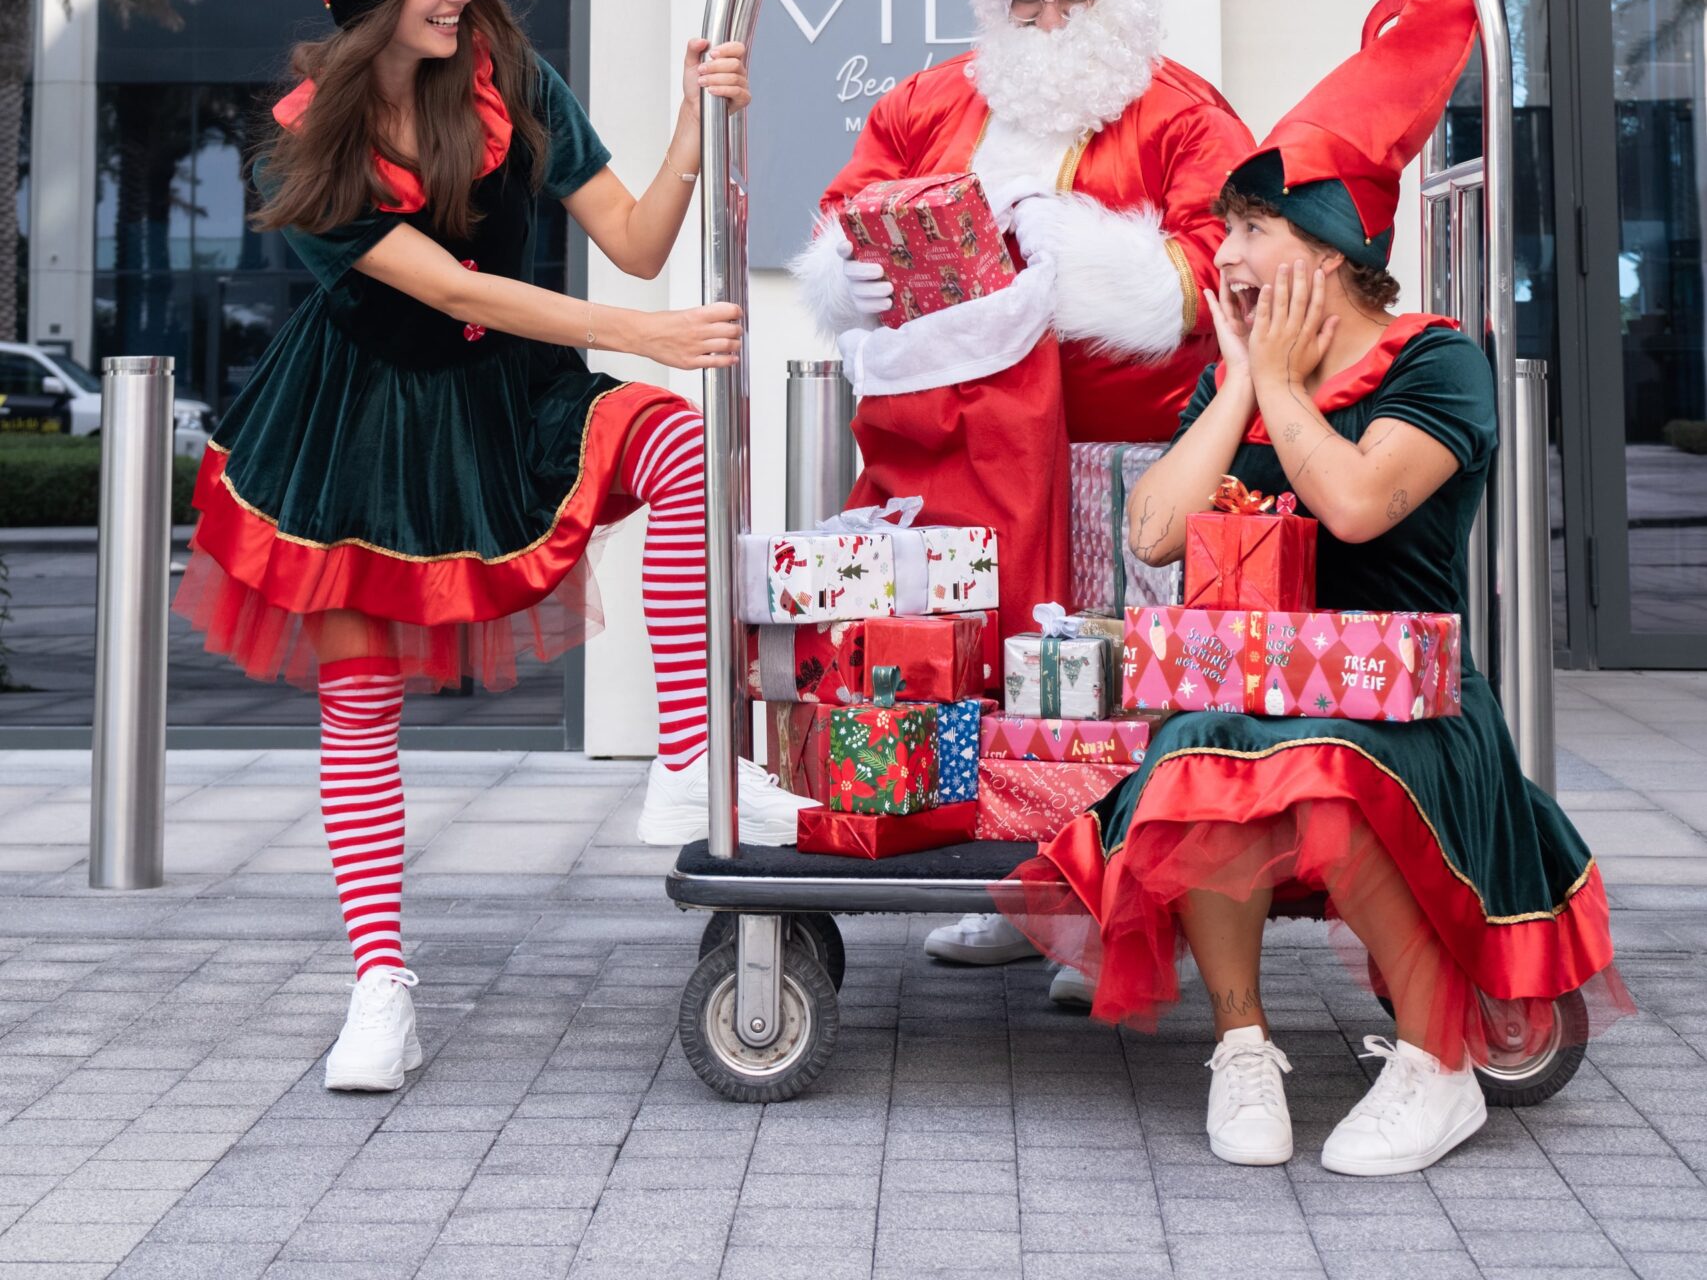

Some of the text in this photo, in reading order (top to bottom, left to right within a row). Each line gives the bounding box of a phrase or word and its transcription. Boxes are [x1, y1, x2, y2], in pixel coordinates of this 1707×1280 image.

[836, 52, 933, 102] Bea
[1187, 627, 1223, 652] SANTA
[1265, 640, 1295, 653] NOW
[1344, 655, 1387, 673] TREAT
[1072, 739, 1115, 756] MERRY
